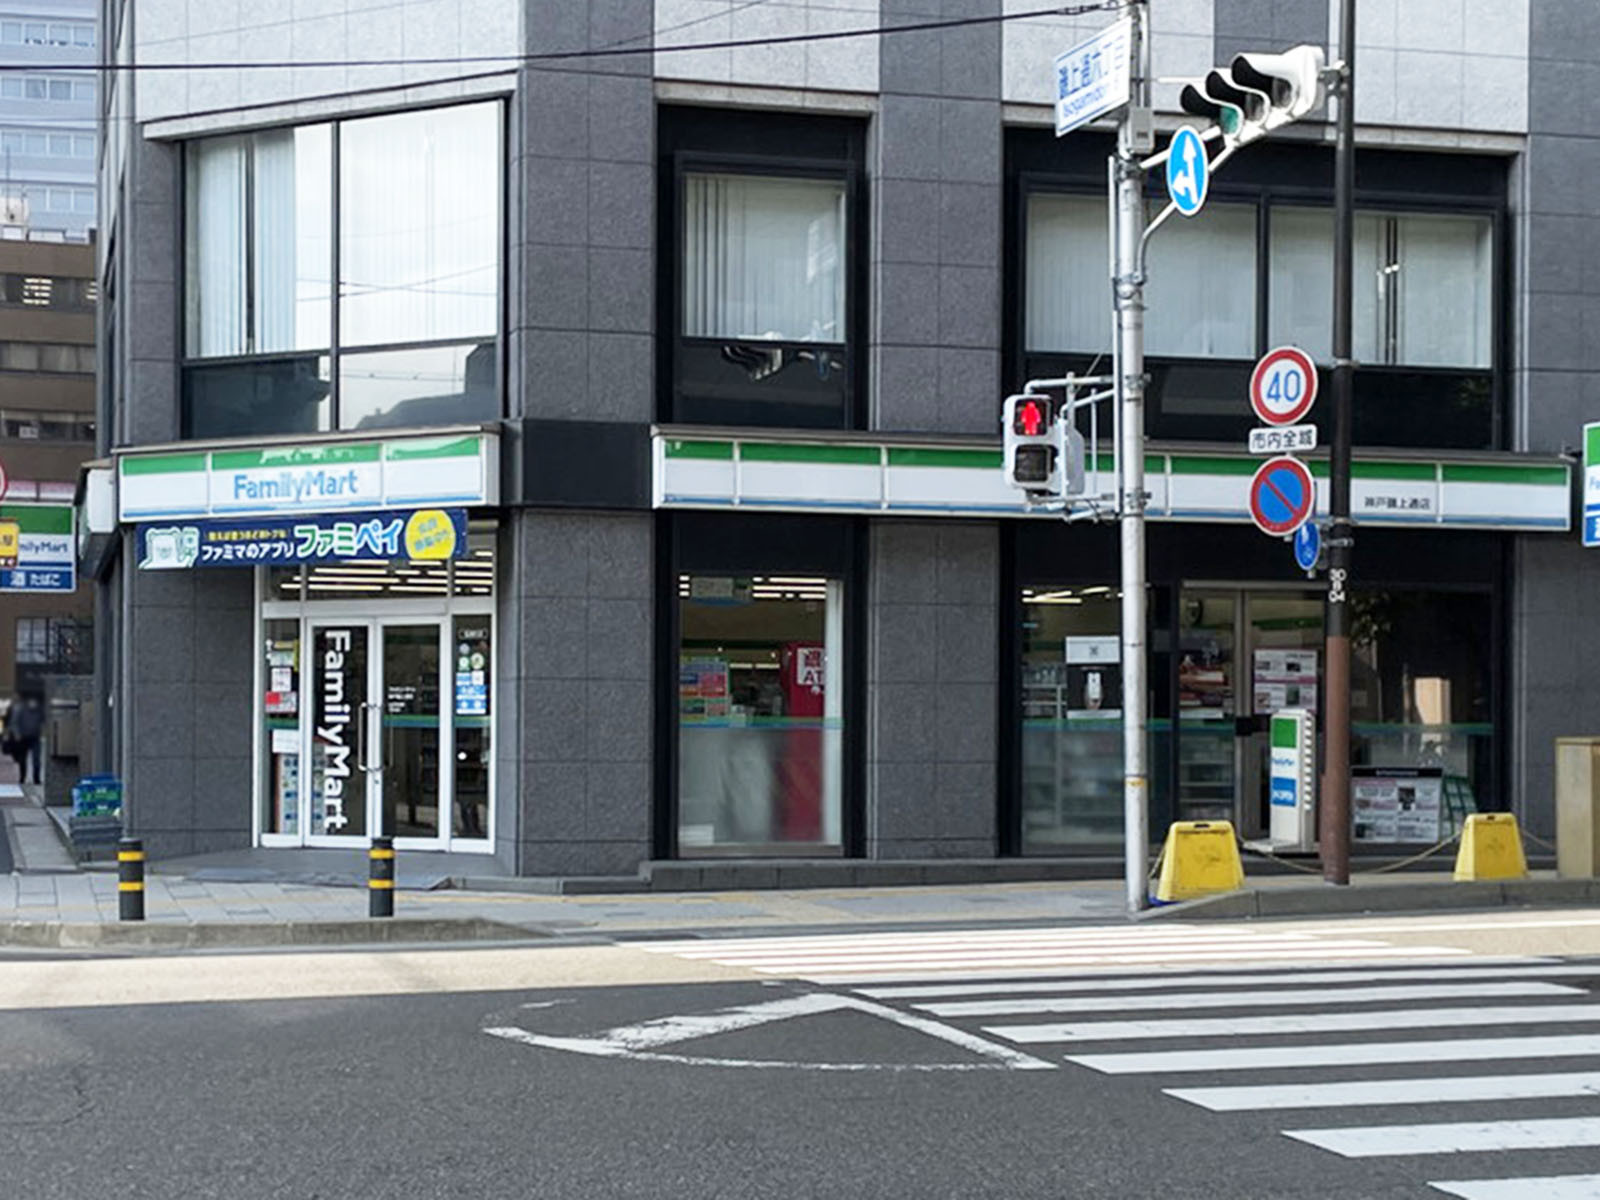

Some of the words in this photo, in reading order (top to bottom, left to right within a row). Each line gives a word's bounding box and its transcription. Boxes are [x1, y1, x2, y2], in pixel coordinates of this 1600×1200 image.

[1267, 369, 1301, 402] 40
[233, 469, 359, 504] FamilyMart
[201, 541, 295, 561] ファミマのアプリ
[294, 518, 404, 558] ファミペイ
[317, 629, 351, 829] FamilyMart
